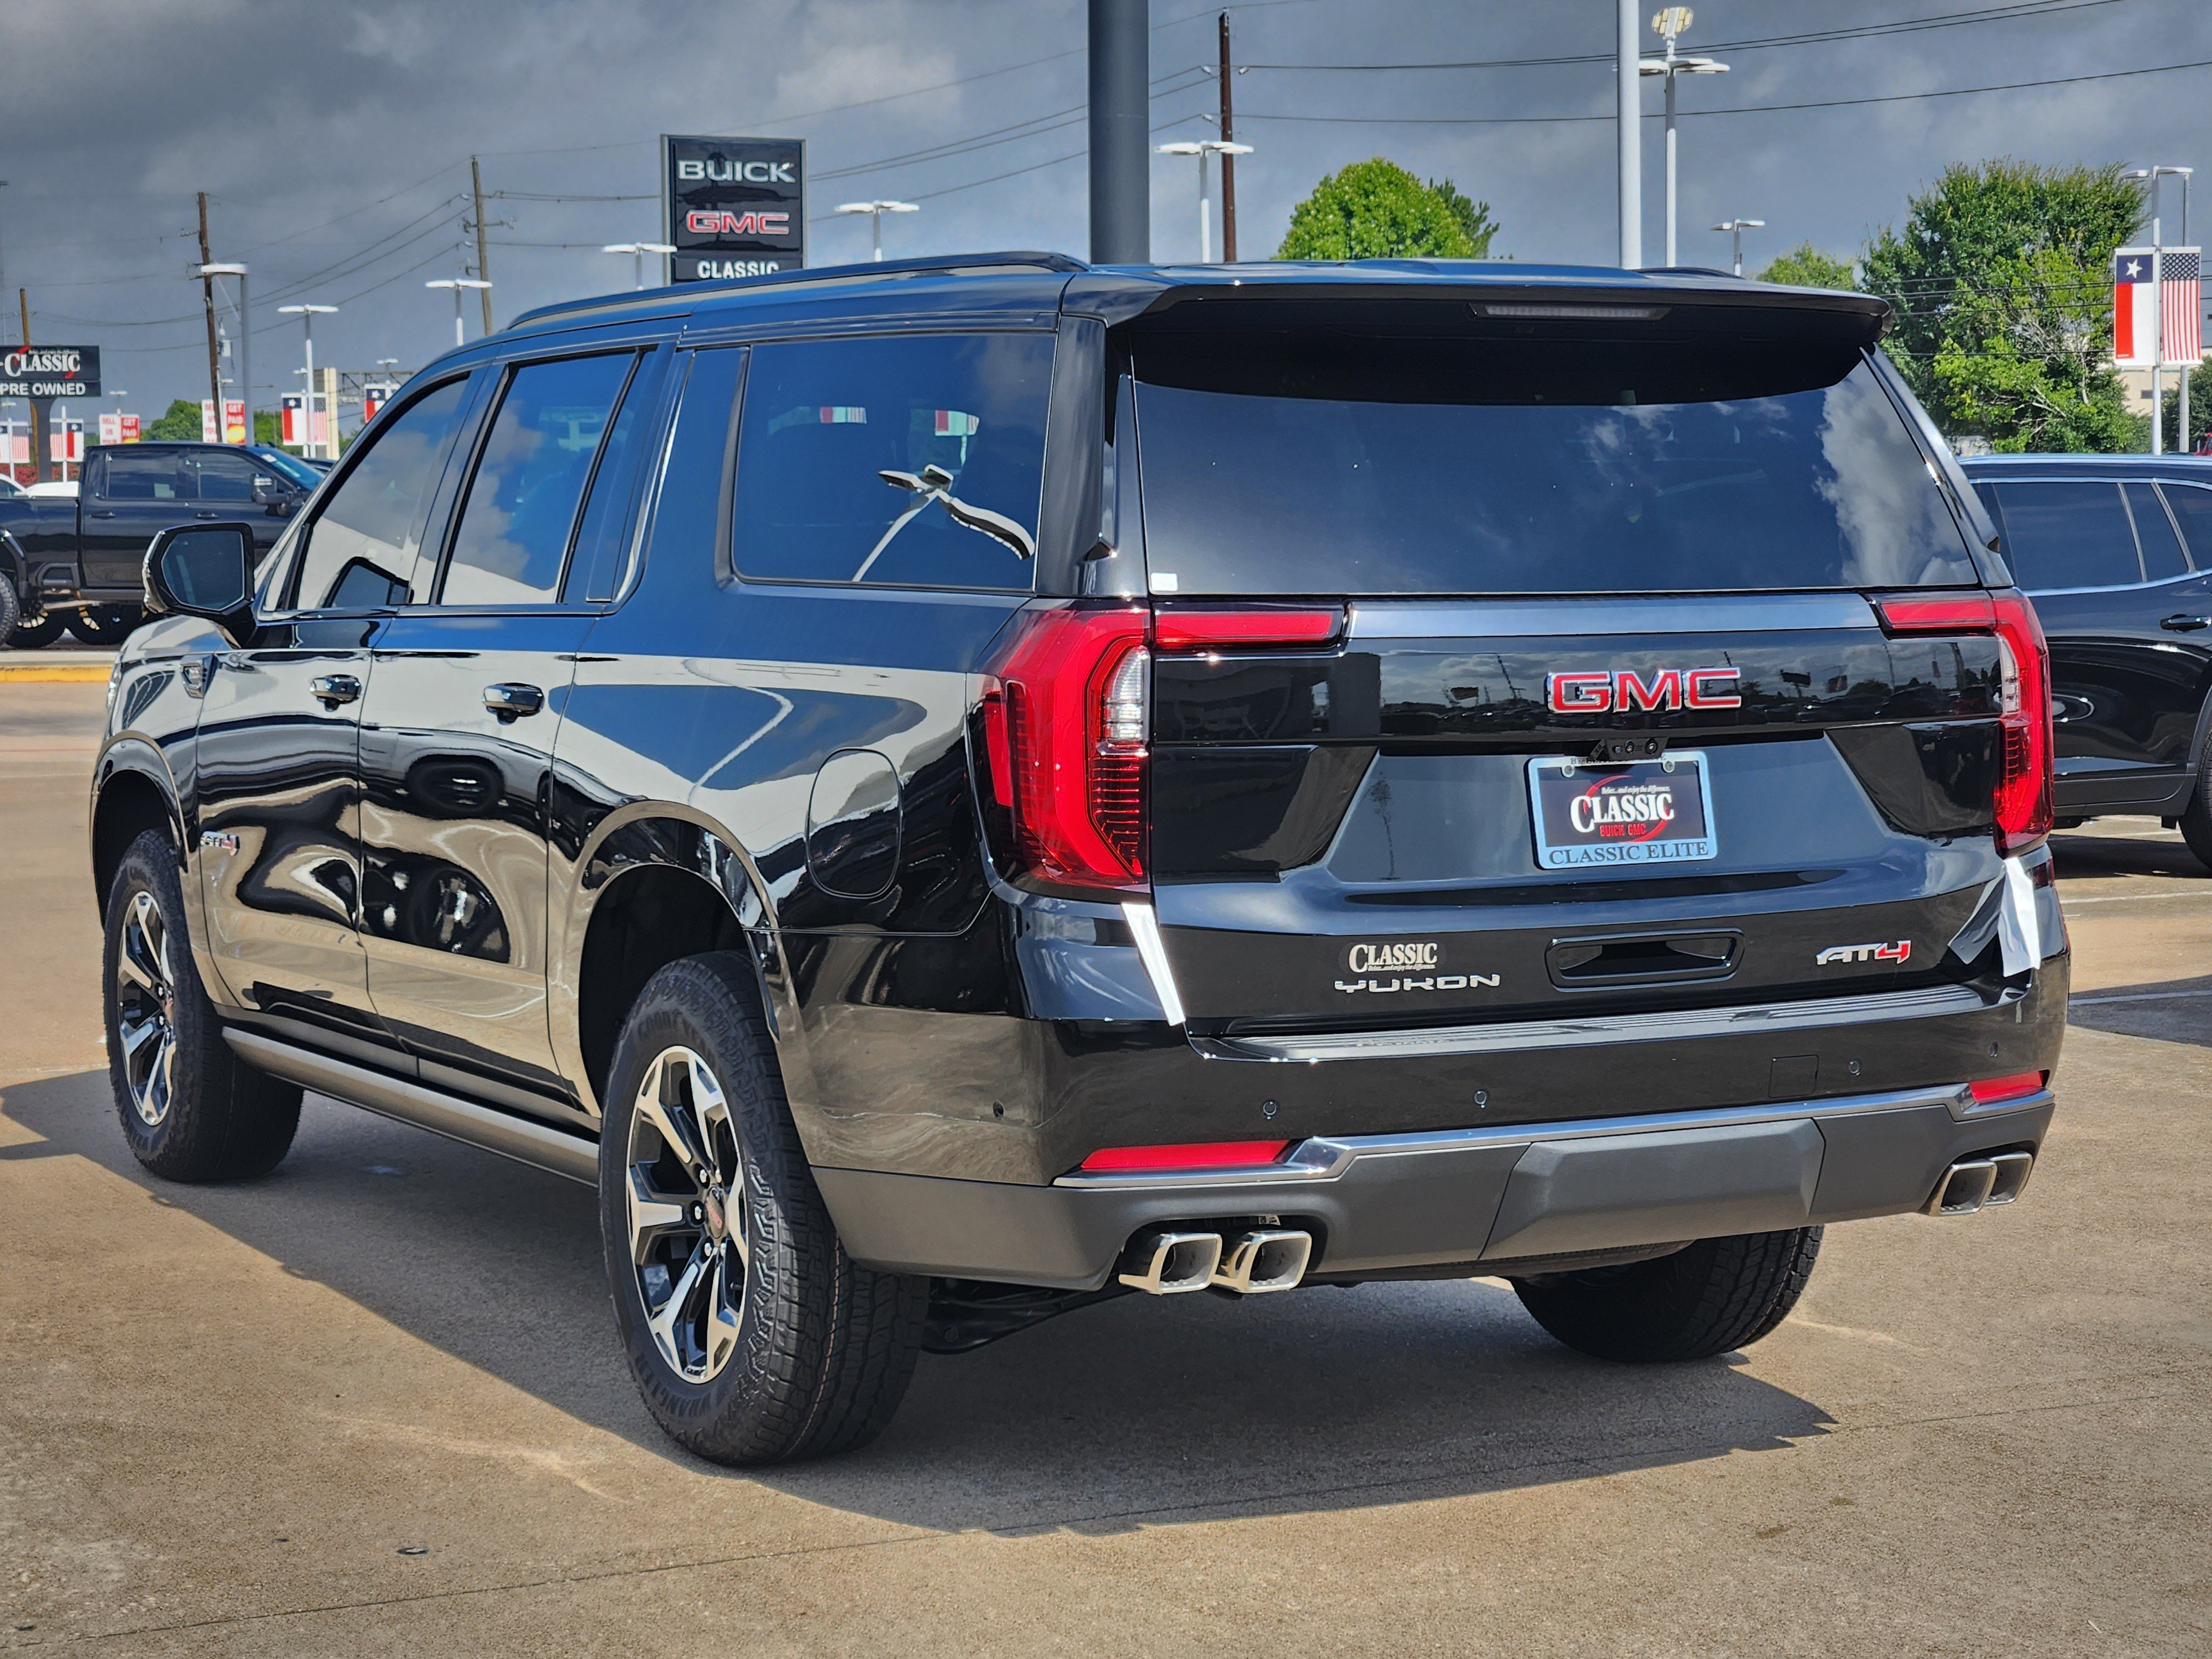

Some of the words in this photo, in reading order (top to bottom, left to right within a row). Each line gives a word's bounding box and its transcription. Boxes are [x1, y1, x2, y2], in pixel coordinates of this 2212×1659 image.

[678, 159, 796, 183] BUICK
[686, 210, 790, 235] GMC
[4, 353, 81, 377] CLASSIC
[0, 383, 29, 395] PRE
[32, 383, 86, 395] OWNED
[227, 415, 243, 424] PAID
[228, 404, 242, 413] GET
[122, 429, 137, 437] PAID
[123, 418, 135, 426] GET
[1547, 667, 1741, 714] GMC
[1570, 793, 1674, 833] CLASSIC
[1599, 824, 1625, 837] BUICK
[1628, 823, 1646, 836] GMC
[1549, 845, 1640, 864] CLASSIC
[1647, 841, 1709, 858] ELITE
[1349, 942, 1438, 973] CLASSIC
[1816, 940, 1912, 966] AT4
[1334, 974, 1500, 993] YUKON
